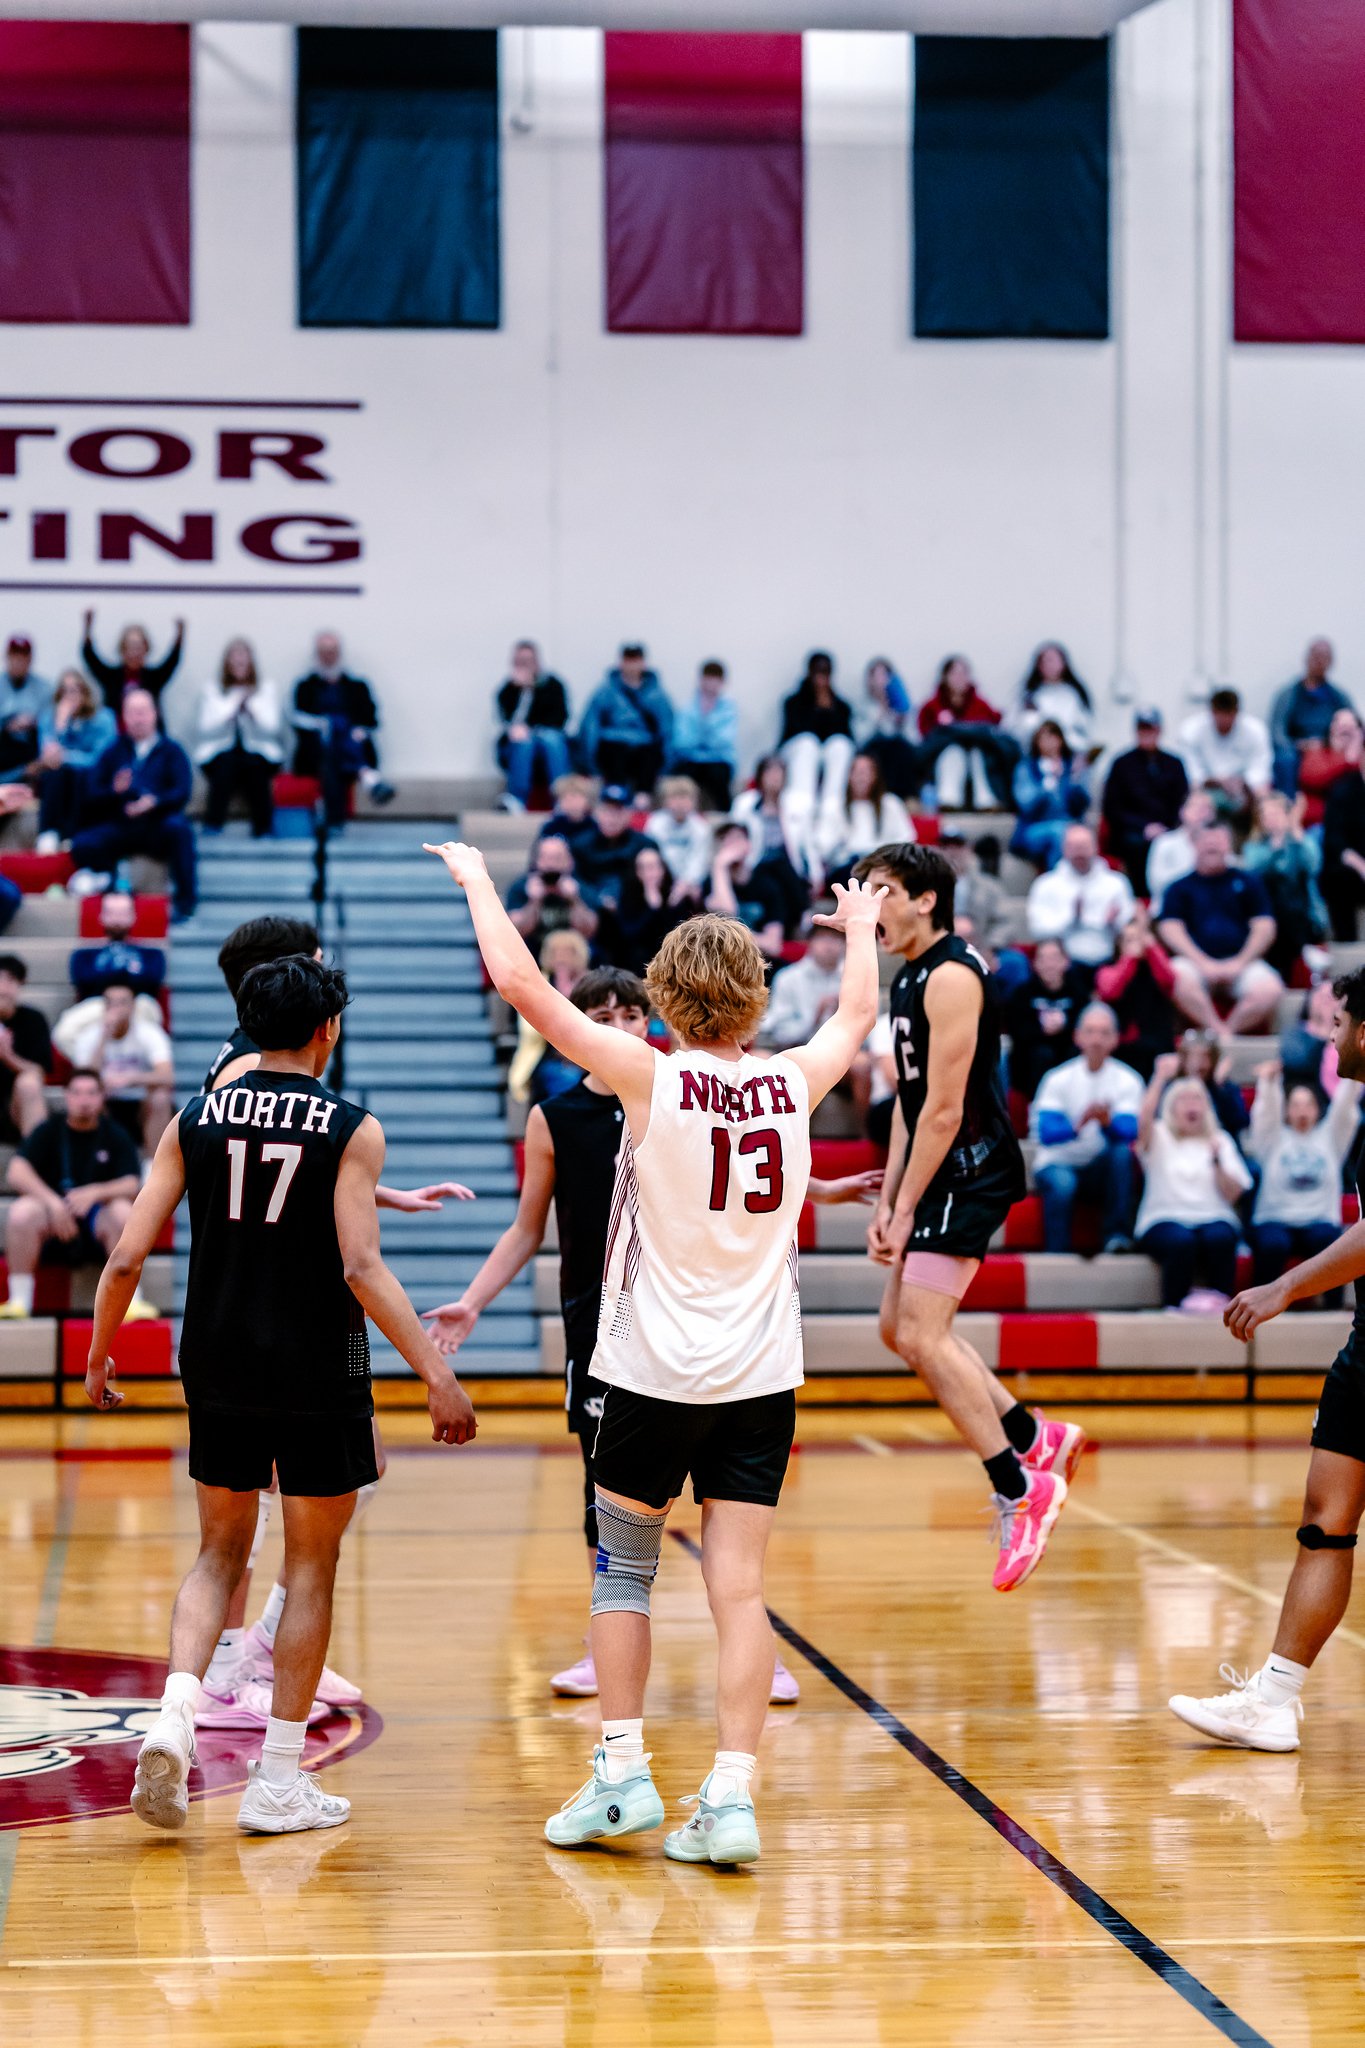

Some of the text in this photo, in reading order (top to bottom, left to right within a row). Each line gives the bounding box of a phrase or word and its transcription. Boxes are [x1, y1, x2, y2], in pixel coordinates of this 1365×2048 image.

[0, 512, 362, 564] ING
[198, 1088, 337, 1134] NORTH
[680, 1070, 796, 1123] NORTH
[226, 1138, 304, 1224] 17
[709, 1126, 784, 1214] 13
